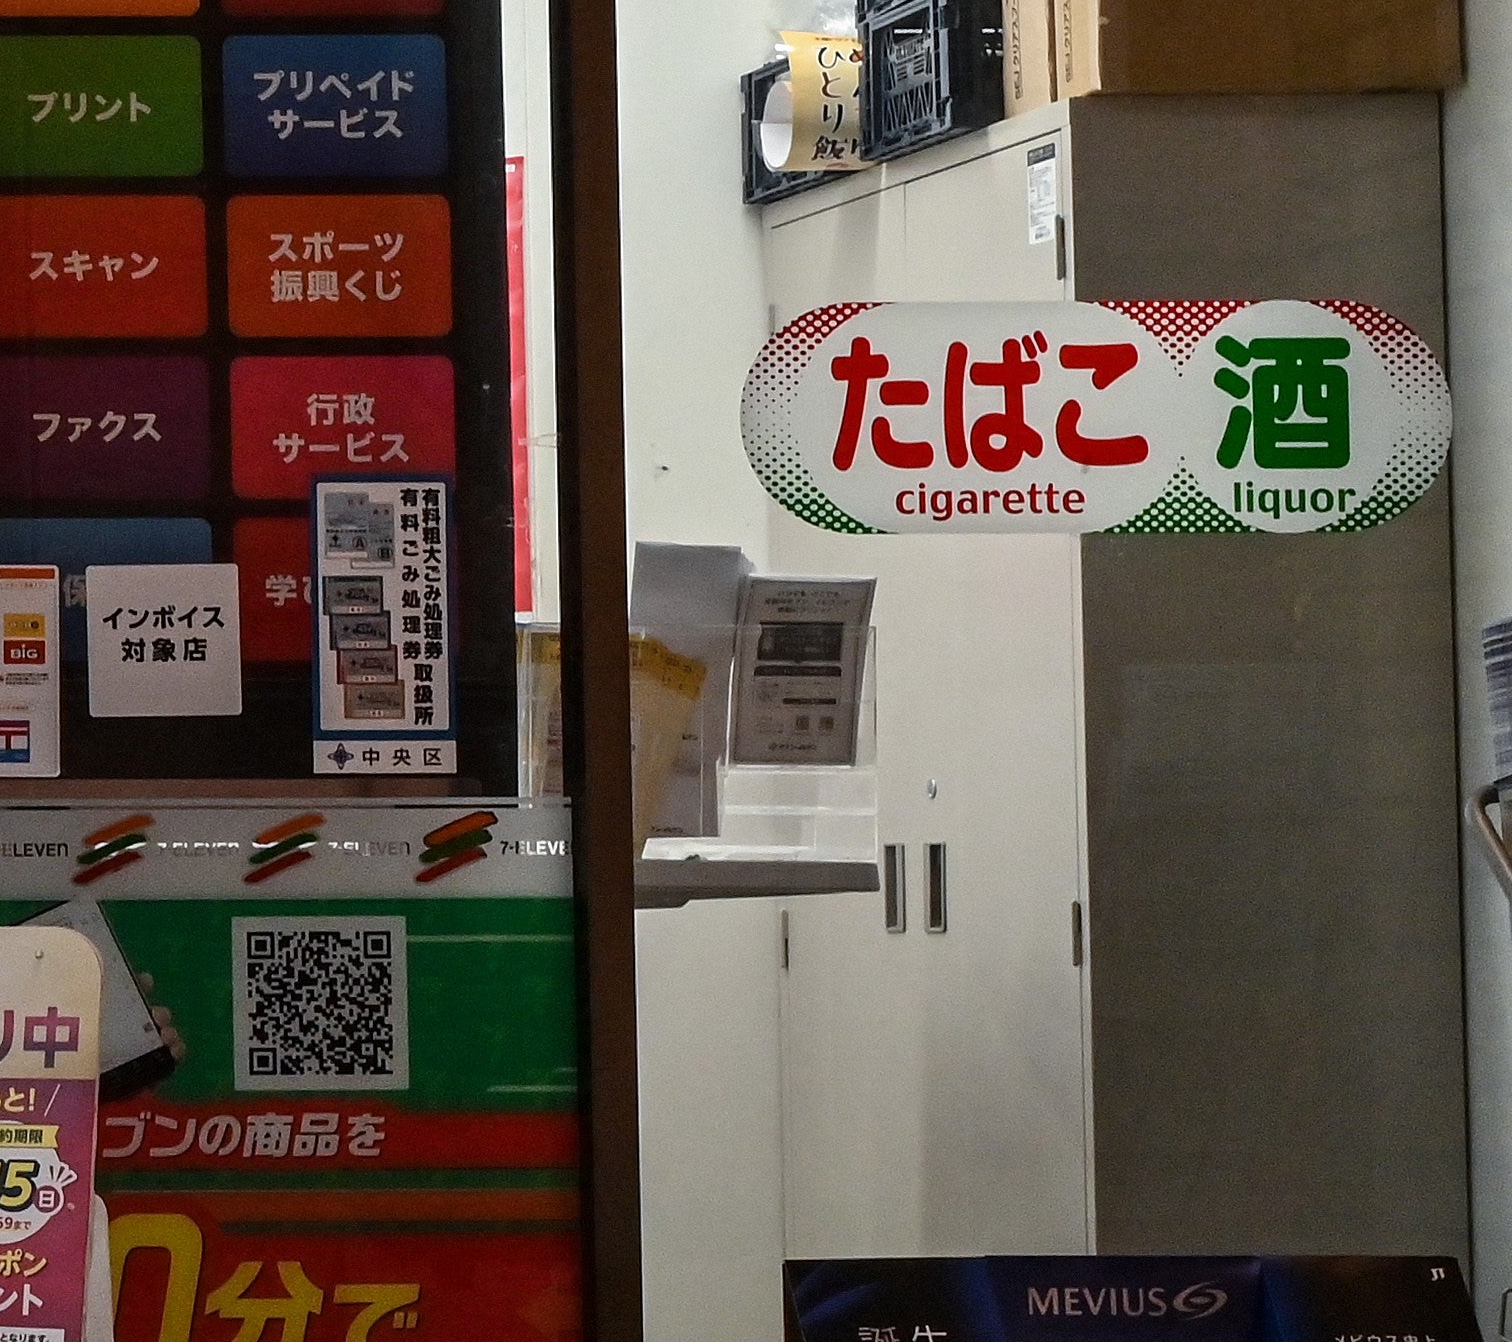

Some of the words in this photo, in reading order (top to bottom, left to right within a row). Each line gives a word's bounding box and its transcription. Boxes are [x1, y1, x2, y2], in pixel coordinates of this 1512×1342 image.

[254, 70, 415, 101] プリペイド
[27, 92, 152, 124] プリント
[268, 108, 403, 140] サービス
[268, 232, 405, 263] スポーツ
[29, 251, 160, 281] スキャン
[270, 269, 403, 302] 振興くじ
[307, 393, 375, 425] 行政
[831, 330, 1150, 473] たばこ
[1213, 335, 1351, 470] 酒
[33, 411, 162, 443] ファクス
[273, 433, 409, 464] サービス
[895, 482, 1086, 524] cigarette
[1232, 481, 1357, 524] liquor
[102, 604, 226, 630] インボイス
[121, 637, 209, 663] 対象店
[361, 746, 444, 767] 中央区
[500, 840, 571, 856] 7-ELEVE
[103, 1113, 386, 1158] ブンの商品を
[1028, 1285, 1168, 1318] MEVIUS
